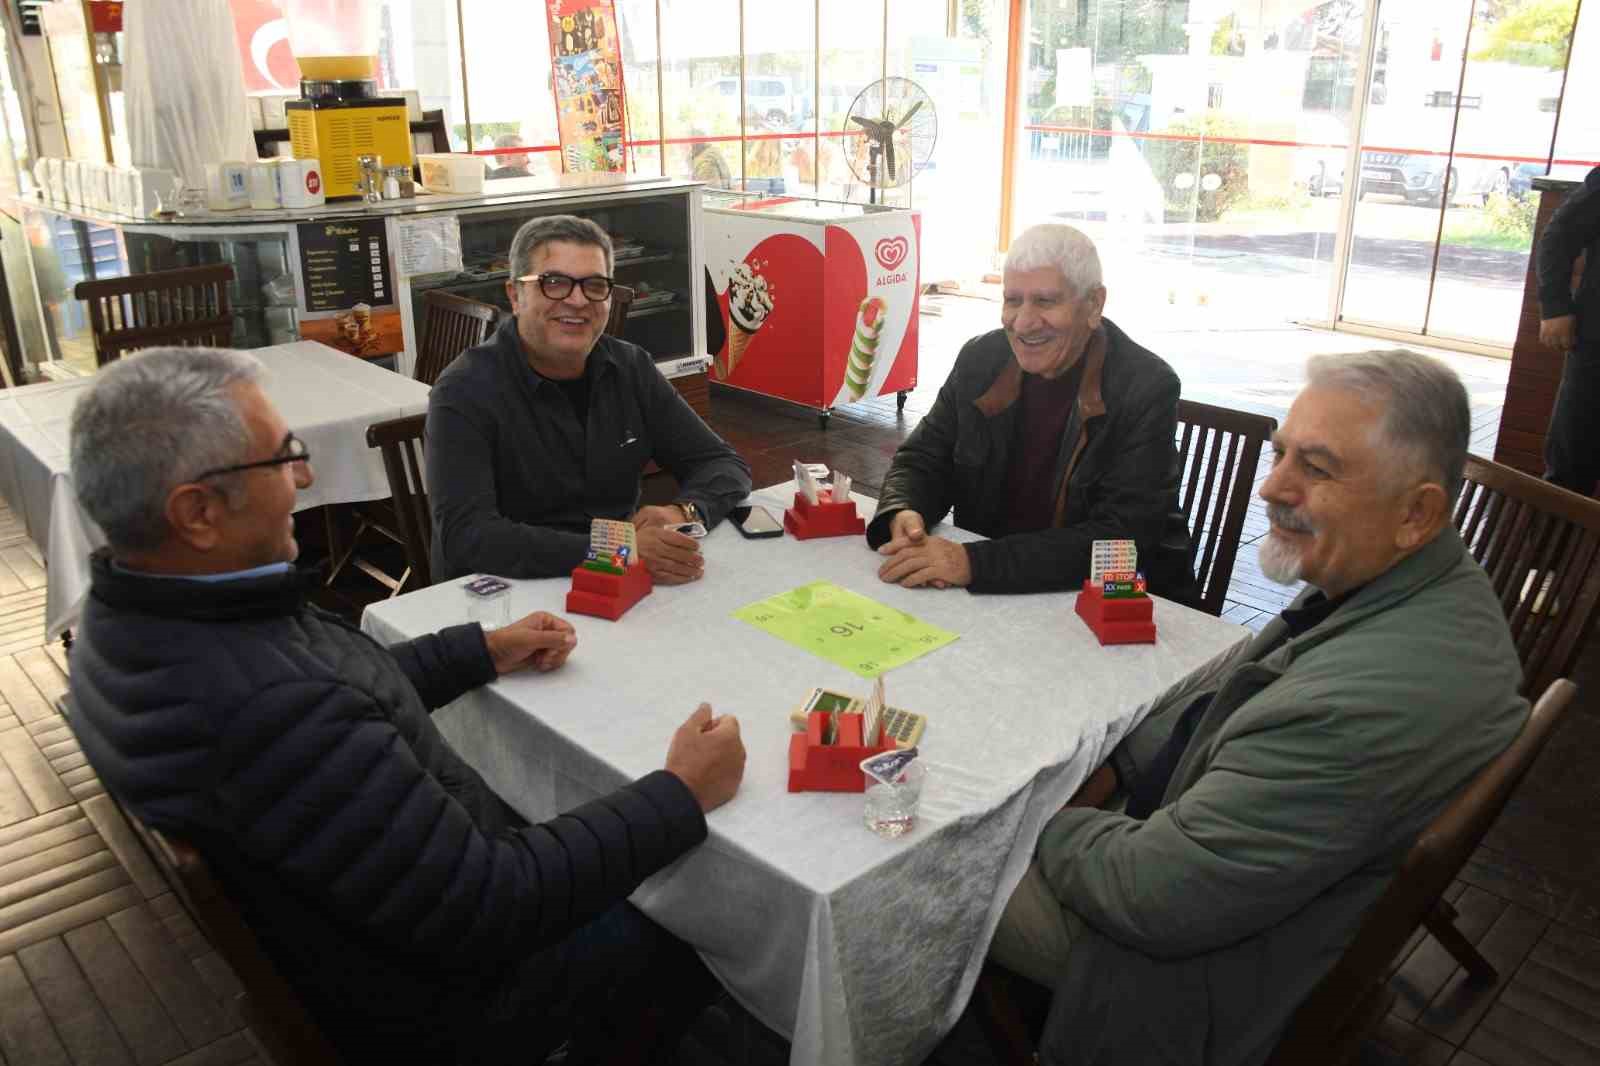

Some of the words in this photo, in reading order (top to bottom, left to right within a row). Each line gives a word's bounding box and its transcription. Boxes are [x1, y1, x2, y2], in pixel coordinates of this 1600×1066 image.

[876, 273, 906, 287] ALGIDA
[1137, 582, 1144, 592] X
[830, 621, 864, 638] 16
